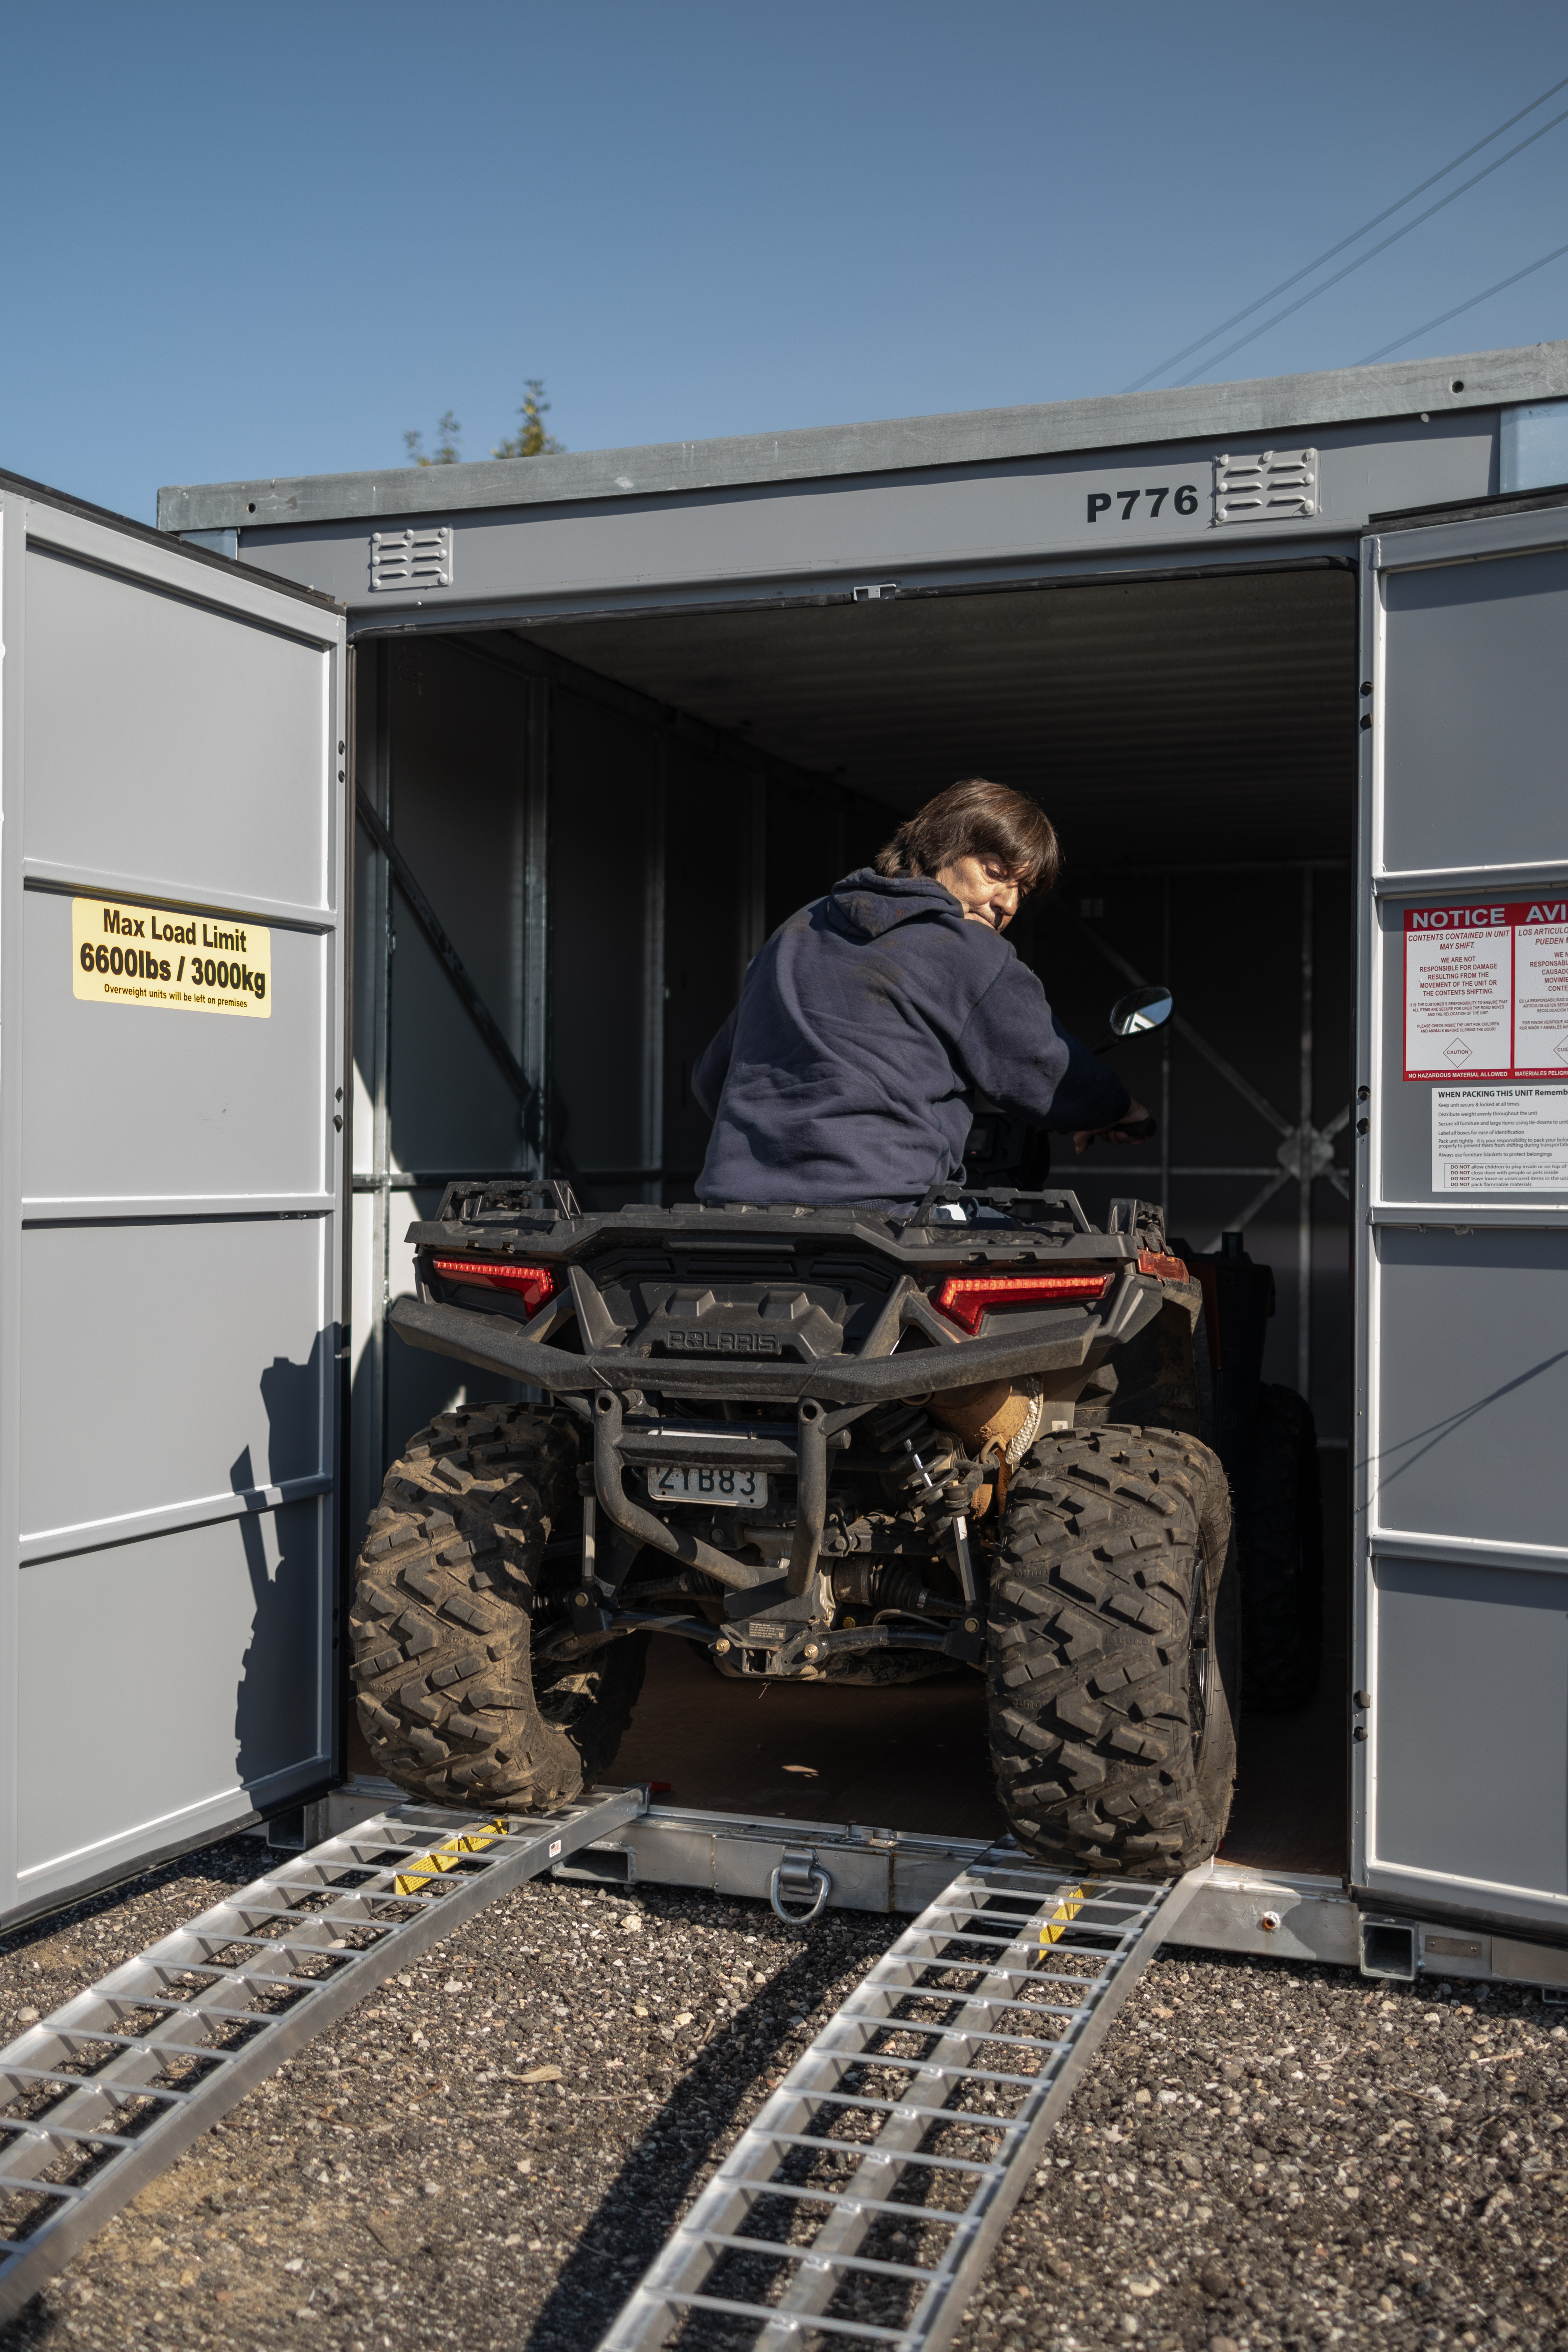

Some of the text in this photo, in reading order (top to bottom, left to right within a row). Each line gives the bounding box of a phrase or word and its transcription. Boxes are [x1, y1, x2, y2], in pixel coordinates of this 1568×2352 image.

[1087, 485, 1198, 523] P776
[1413, 908, 1505, 928] NOTICE
[1525, 904, 1568, 922] AVI
[104, 908, 247, 952] Max Load Limit
[1408, 934, 1443, 942] CONTENTS
[1445, 931, 1484, 940] CONTAINED
[80, 942, 265, 999] 6600lbs / 3000kg
[104, 983, 147, 998] Overweight
[149, 989, 166, 999] units
[169, 991, 181, 1000] will
[184, 992, 191, 1001] be
[194, 993, 205, 1003] left
[218, 998, 247, 1007] premises
[668, 1330, 776, 1351] POLARIS
